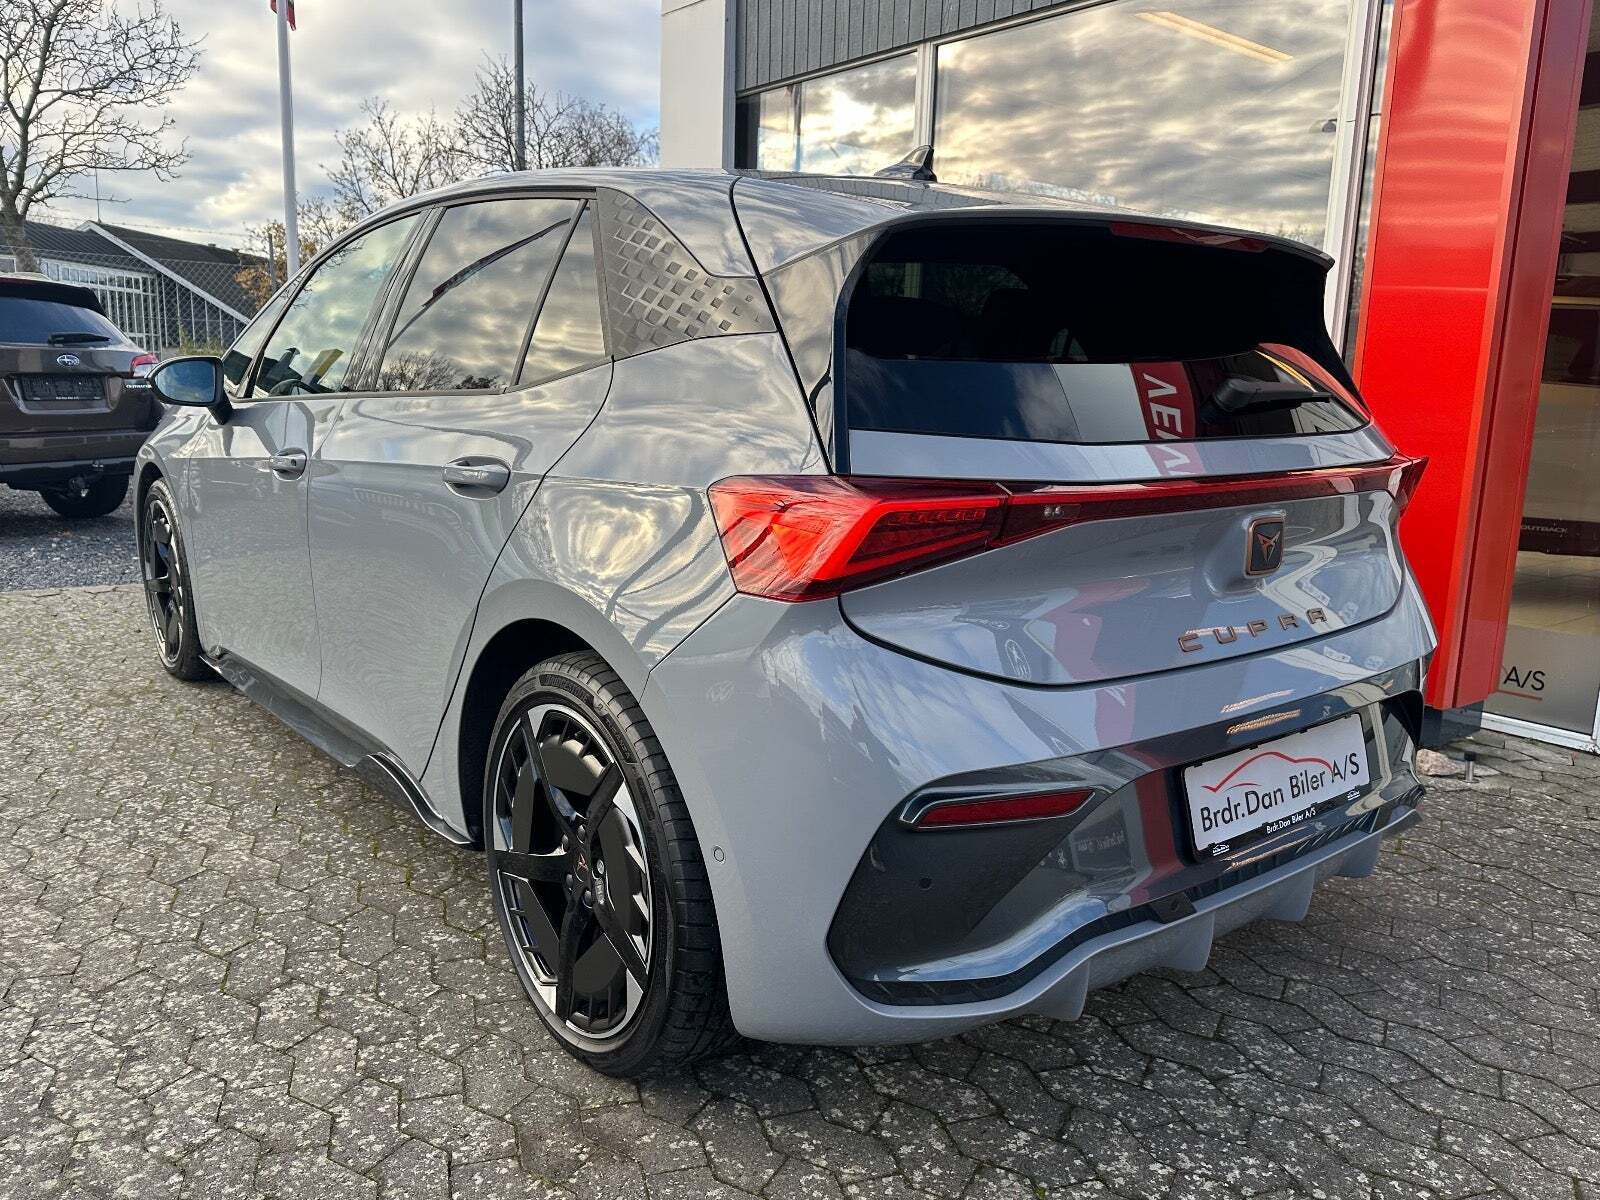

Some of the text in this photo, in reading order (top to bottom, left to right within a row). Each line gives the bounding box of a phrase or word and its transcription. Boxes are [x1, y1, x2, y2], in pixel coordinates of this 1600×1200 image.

[1520, 524, 1568, 534] OUTBACK
[1177, 607, 1328, 653] CUPRA
[1503, 665, 1546, 691] A/S
[1289, 769, 1326, 799] Biler
[1331, 752, 1360, 783] A/S
[1292, 814, 1304, 824] Biler
[1305, 807, 1317, 819] A/S
